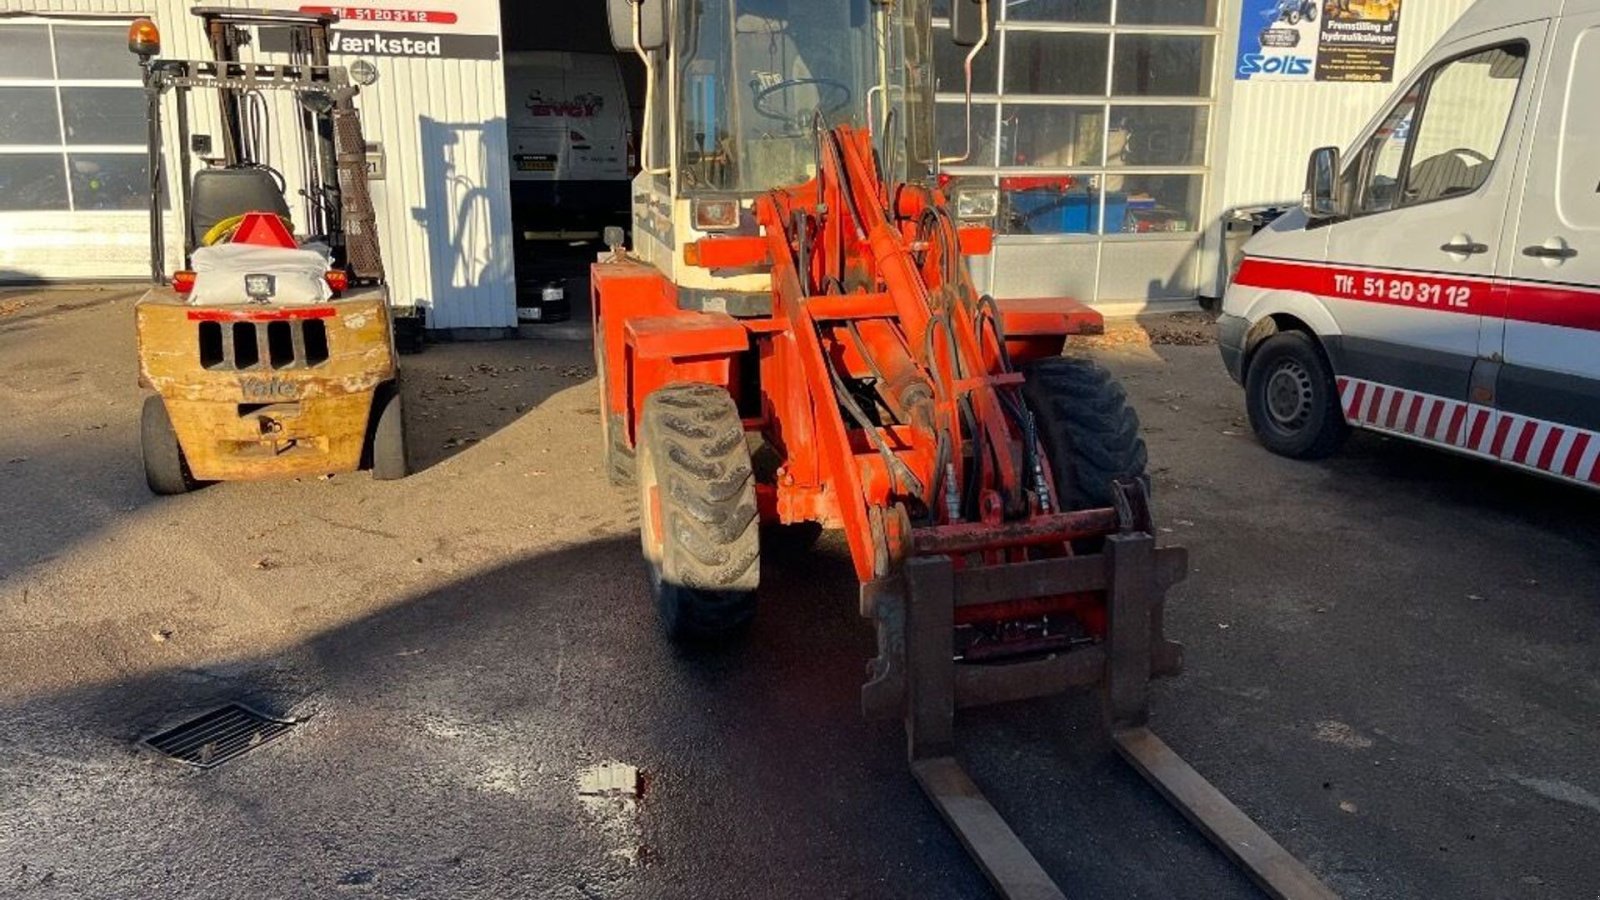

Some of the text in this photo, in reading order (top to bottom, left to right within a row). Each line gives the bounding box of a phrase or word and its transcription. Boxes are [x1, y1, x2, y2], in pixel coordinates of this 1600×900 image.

[356, 9, 371, 20] 51
[375, 10, 391, 20] 20
[394, 11, 409, 21] 31
[413, 12, 428, 22] 12
[1327, 20, 1393, 32] Fremstilling af
[1334, 275, 1470, 307] Tlf. 51 20 31 12
